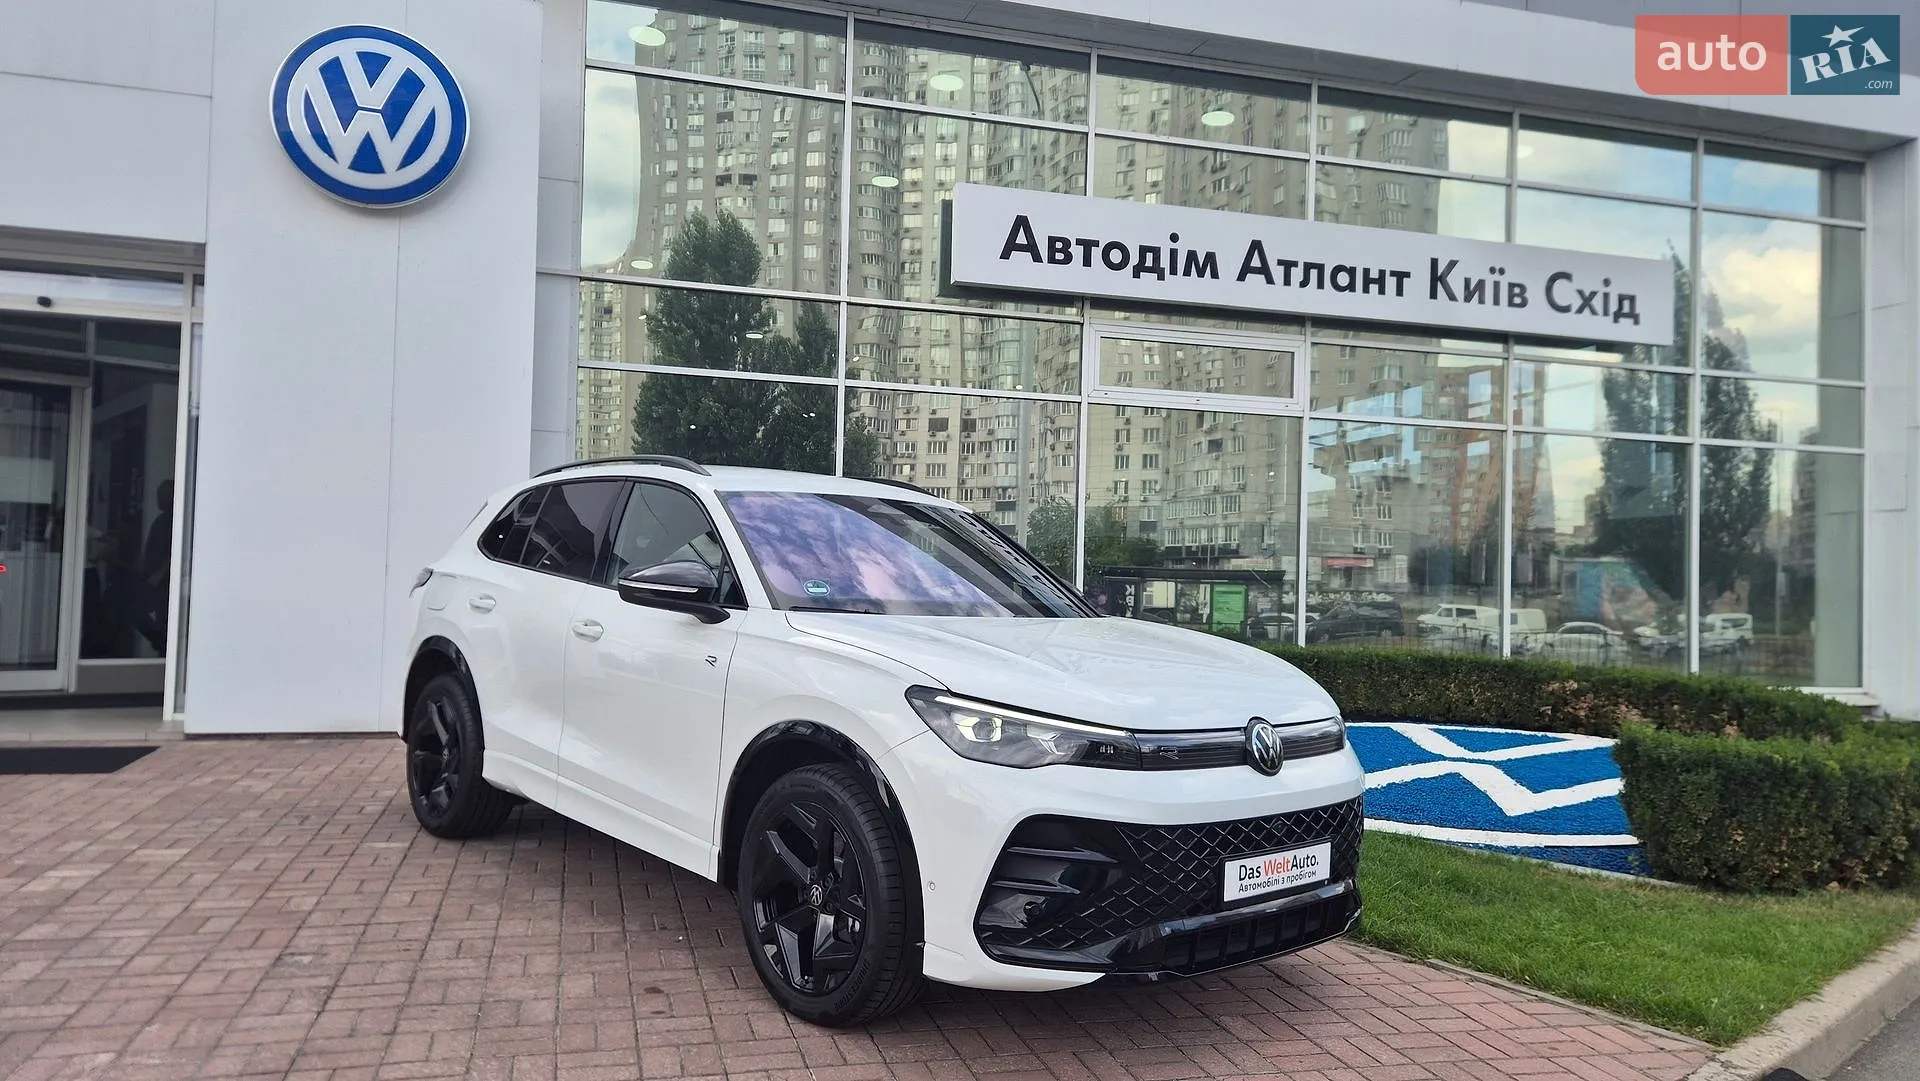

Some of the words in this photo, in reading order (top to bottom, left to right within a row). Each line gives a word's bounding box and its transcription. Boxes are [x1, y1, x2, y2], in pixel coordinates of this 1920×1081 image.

[999, 214, 1220, 281] Автодім
[1236, 239, 1411, 297] Атлант
[1428, 257, 1529, 308] Київ
[1545, 271, 1641, 325] Схід
[1238, 877, 1280, 893] Автомобілі
[1286, 870, 1317, 884] пробігом
[1239, 864, 1261, 881] Das
